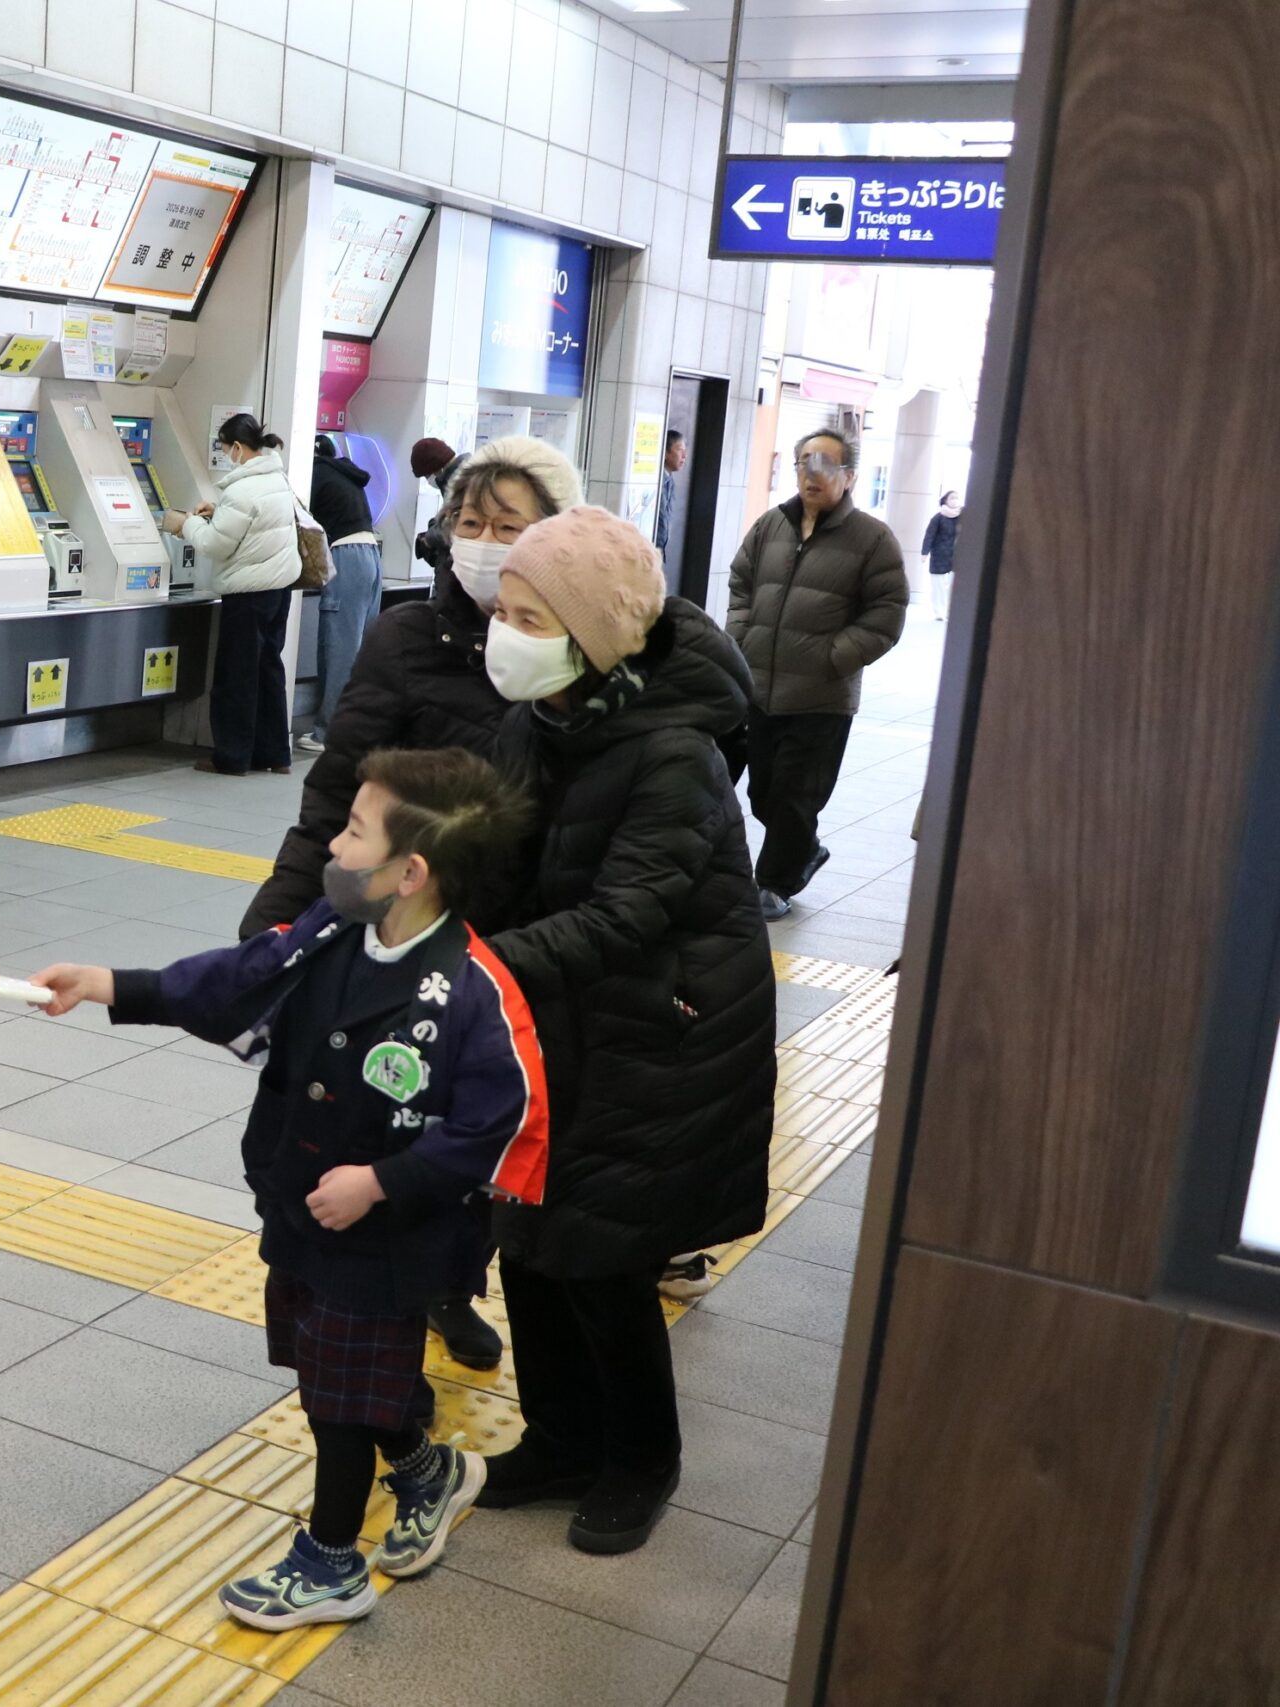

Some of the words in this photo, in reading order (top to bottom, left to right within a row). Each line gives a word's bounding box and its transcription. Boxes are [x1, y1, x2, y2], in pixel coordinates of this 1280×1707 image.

[858, 211, 912, 225] Tickets
[132, 244, 196, 272] 調整中
